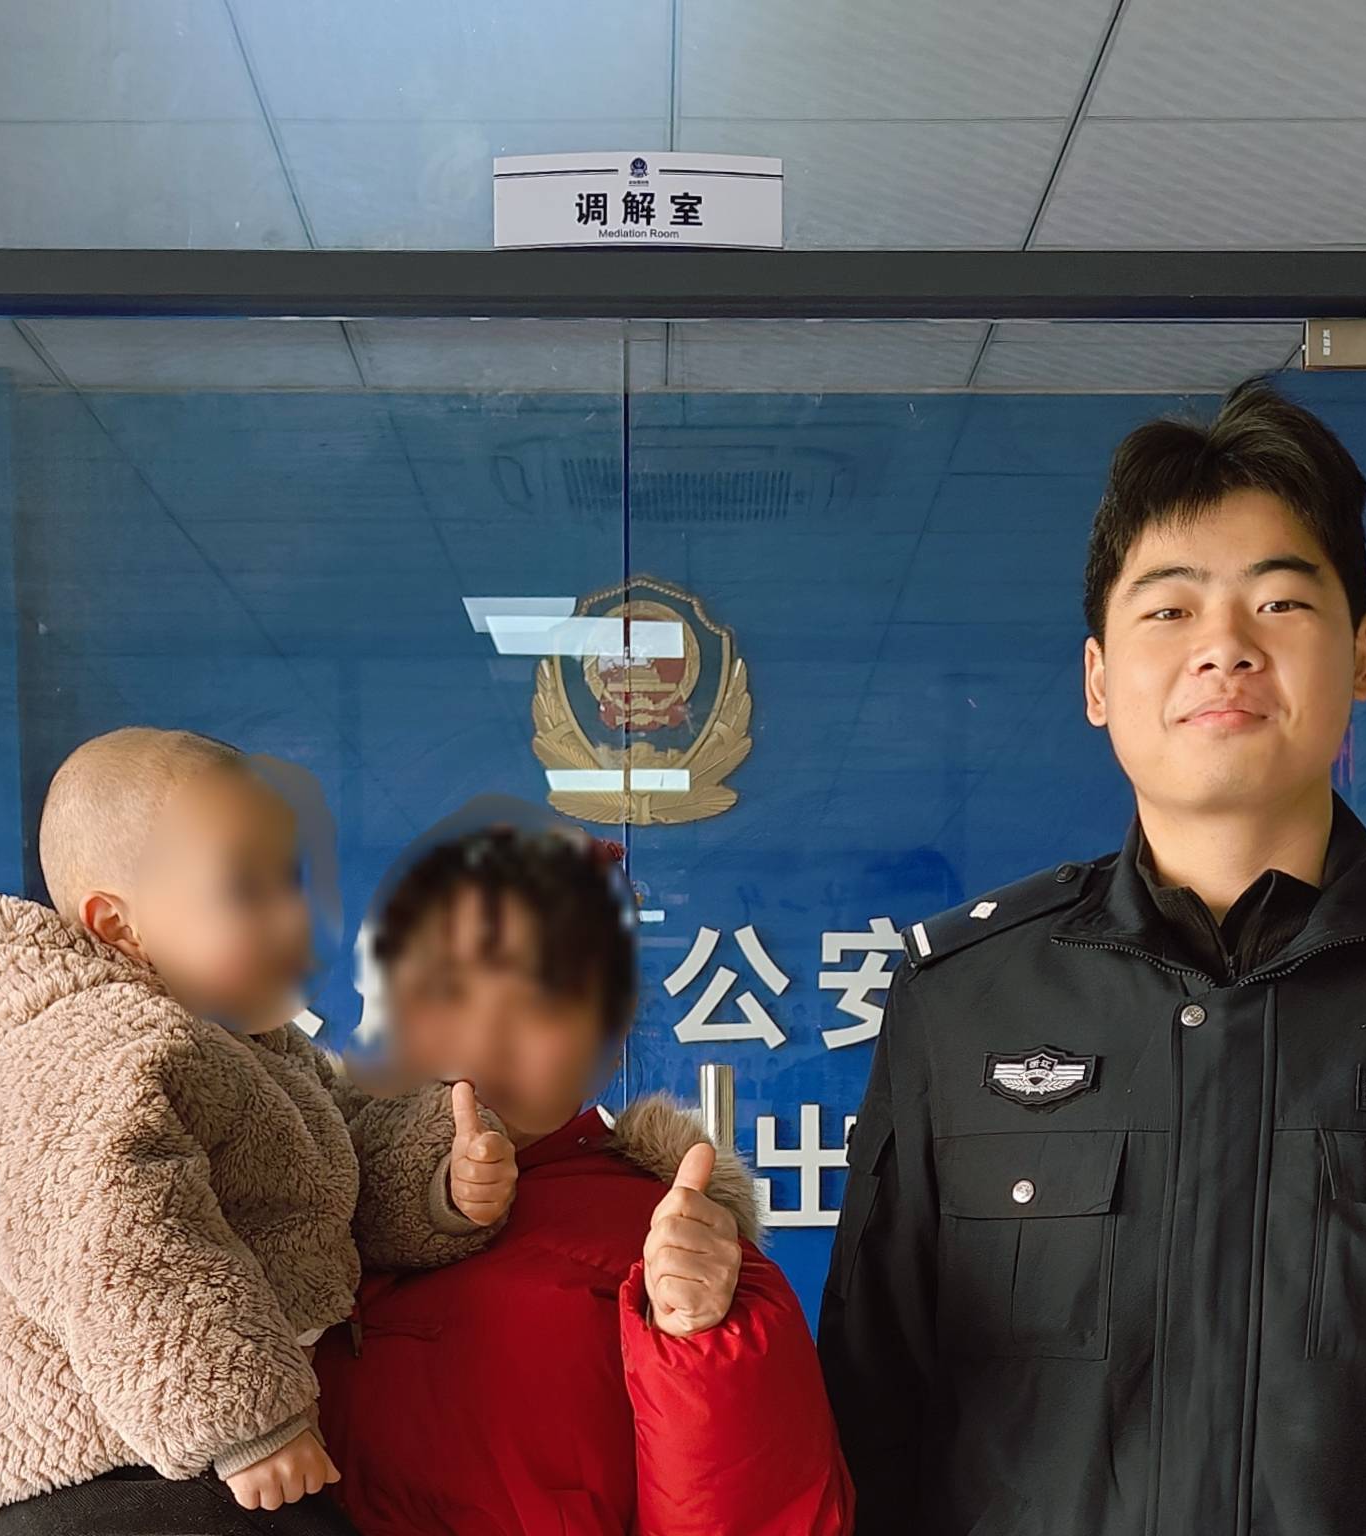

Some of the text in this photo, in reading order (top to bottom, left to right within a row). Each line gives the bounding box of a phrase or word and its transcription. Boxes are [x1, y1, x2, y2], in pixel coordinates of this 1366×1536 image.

[575, 191, 703, 226] 调解室
[598, 228, 680, 239] Mediation Room
